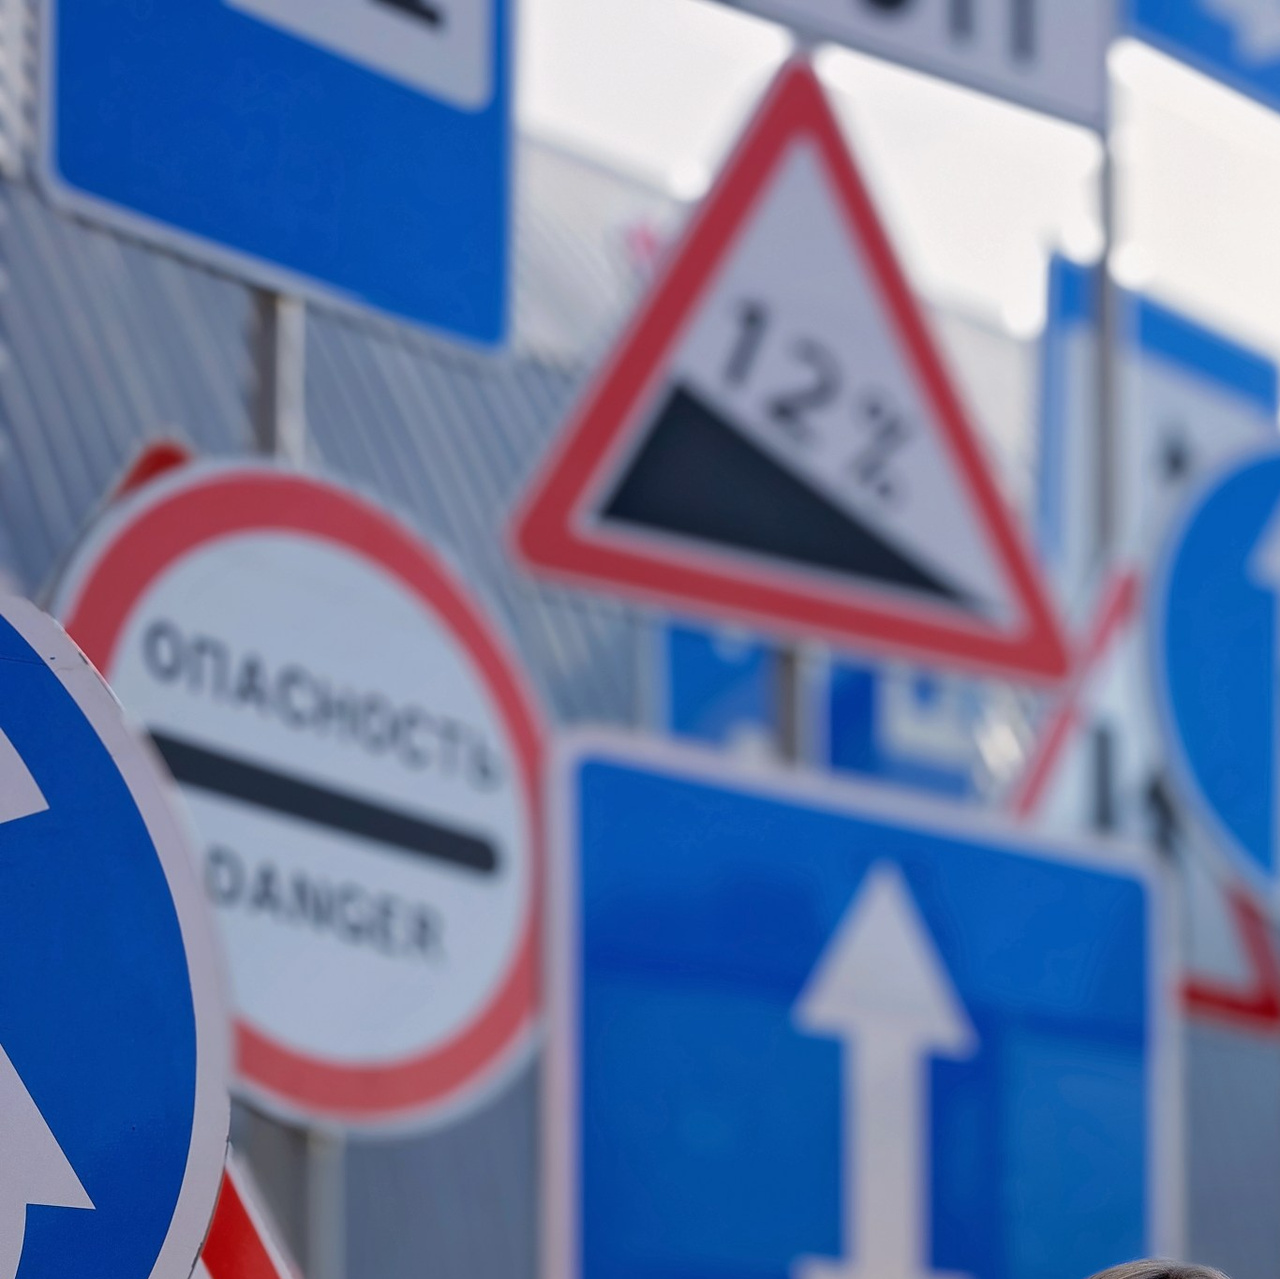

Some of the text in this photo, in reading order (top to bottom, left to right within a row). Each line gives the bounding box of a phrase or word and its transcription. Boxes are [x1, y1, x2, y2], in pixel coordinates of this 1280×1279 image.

[722, 300, 914, 506] 12%
[142, 618, 502, 792] ОПАСНОСТЬ
[205, 842, 448, 967] DANGER
